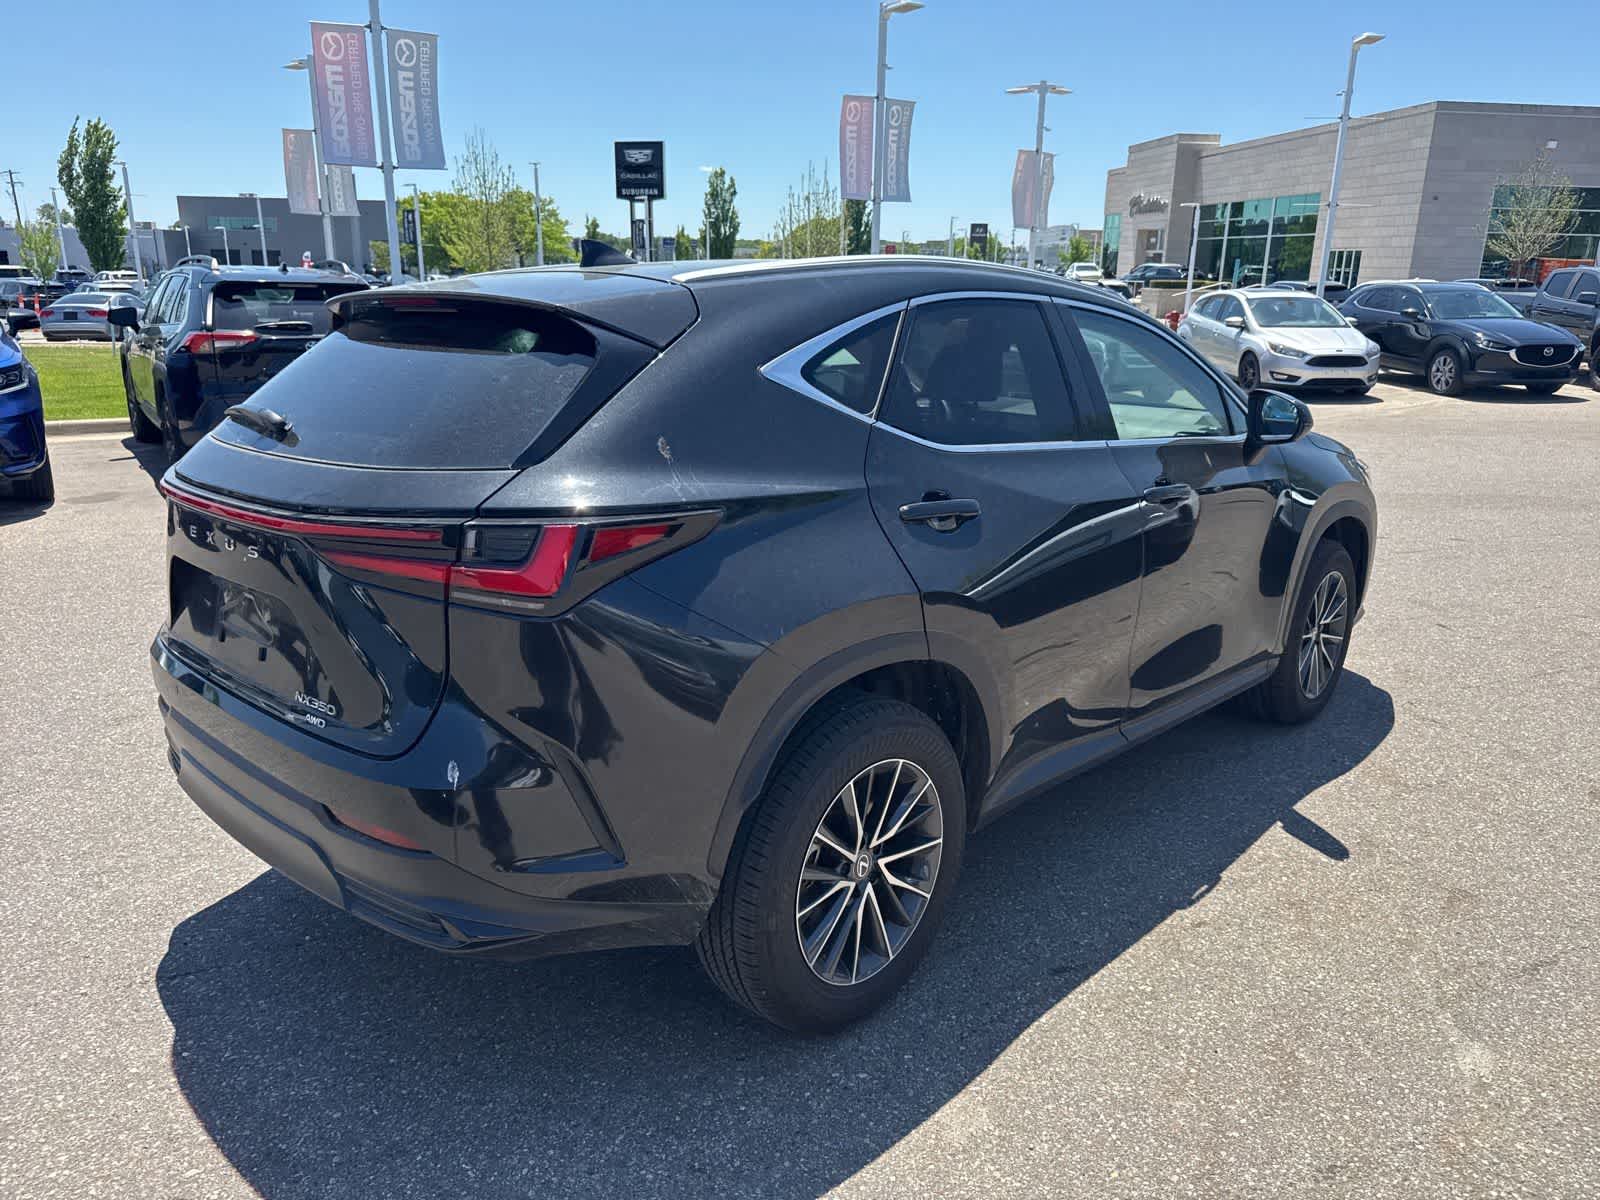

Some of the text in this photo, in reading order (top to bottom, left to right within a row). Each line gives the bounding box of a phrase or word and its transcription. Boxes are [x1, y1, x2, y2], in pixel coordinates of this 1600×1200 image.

[177, 520, 259, 558] EXUS
[295, 691, 336, 715] NX350
[305, 714, 326, 728] AWD
